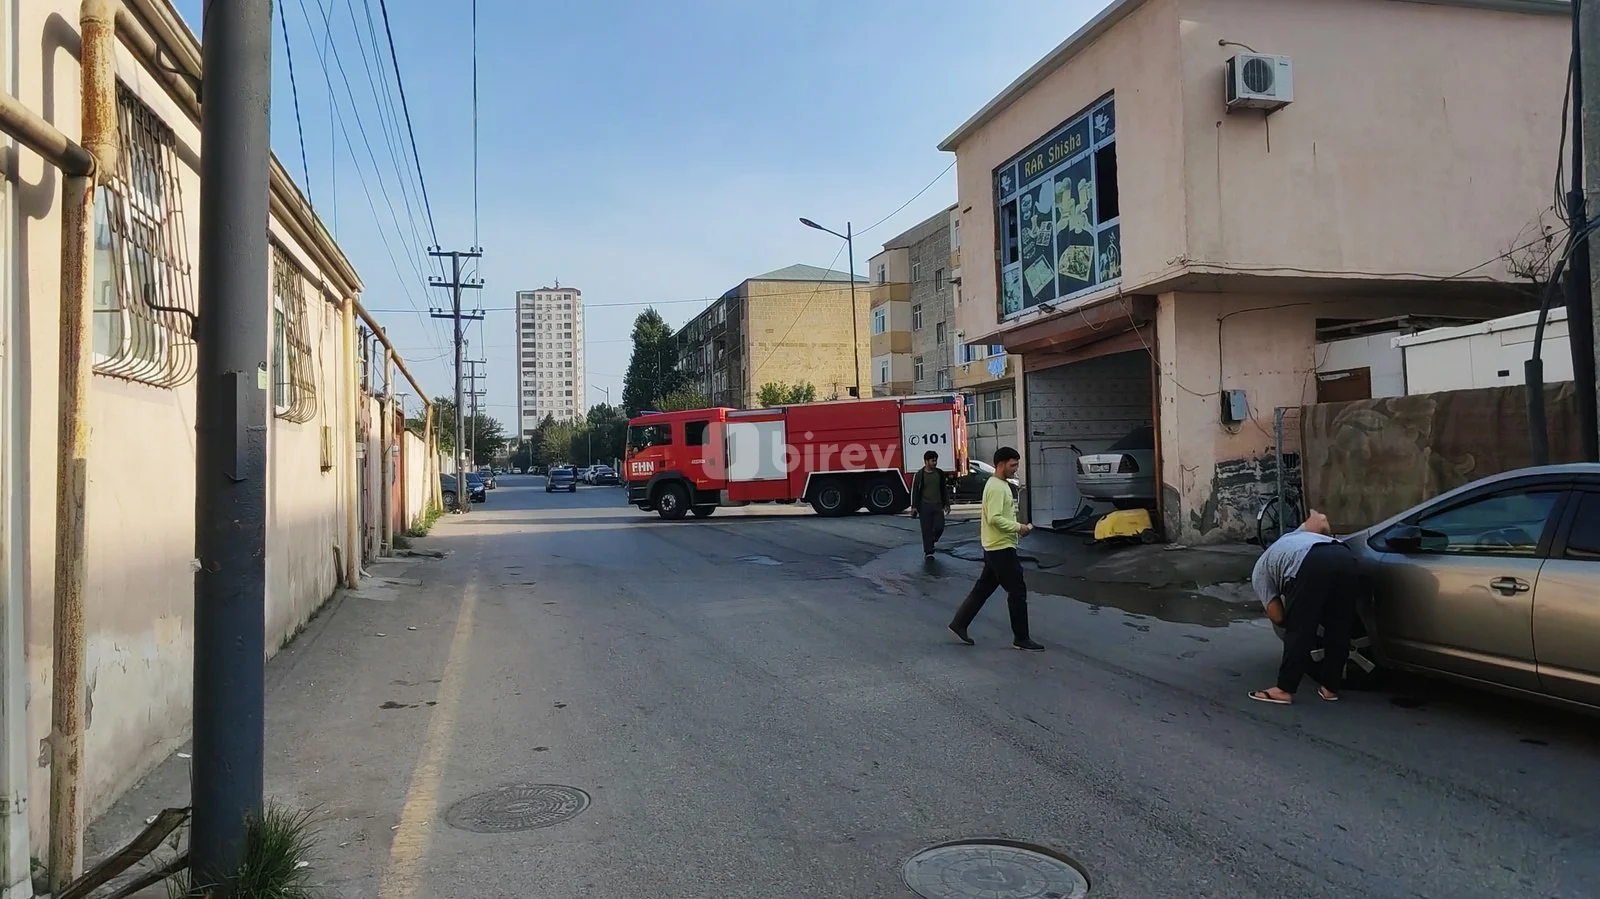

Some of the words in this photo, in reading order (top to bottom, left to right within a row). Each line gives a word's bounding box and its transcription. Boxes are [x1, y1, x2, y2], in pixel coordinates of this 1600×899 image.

[1048, 133, 1082, 164] Shisha
[921, 432, 947, 445] 101
[631, 461, 655, 472] FHN
